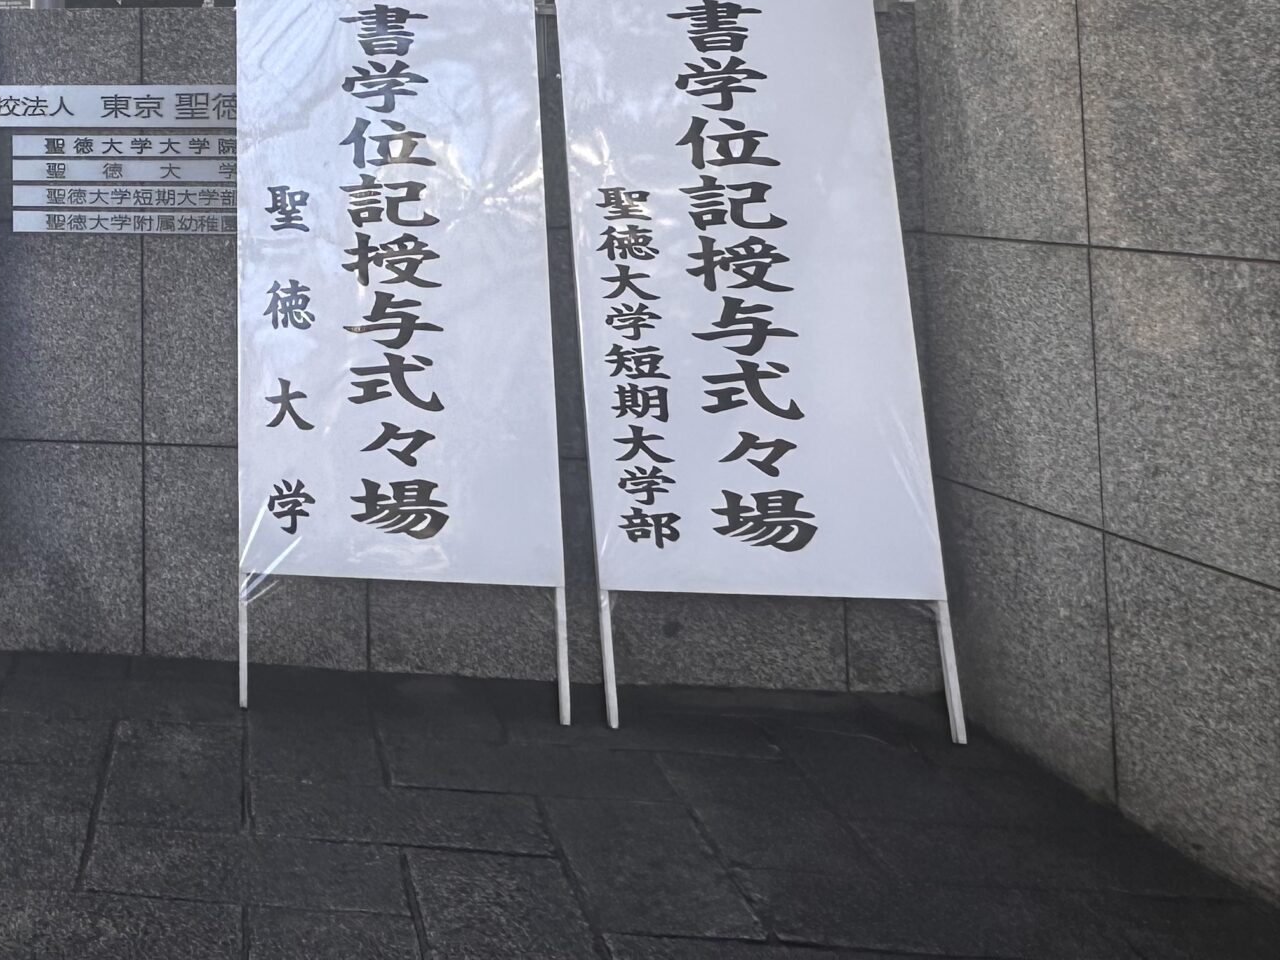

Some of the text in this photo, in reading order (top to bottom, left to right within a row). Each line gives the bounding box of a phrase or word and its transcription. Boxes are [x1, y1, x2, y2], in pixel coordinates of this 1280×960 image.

[44, 138, 237, 155] 聖徳大学大学院
[264, 185, 317, 535] 聖徳大学
[596, 187, 681, 549] 聖徳大学短期大学部
